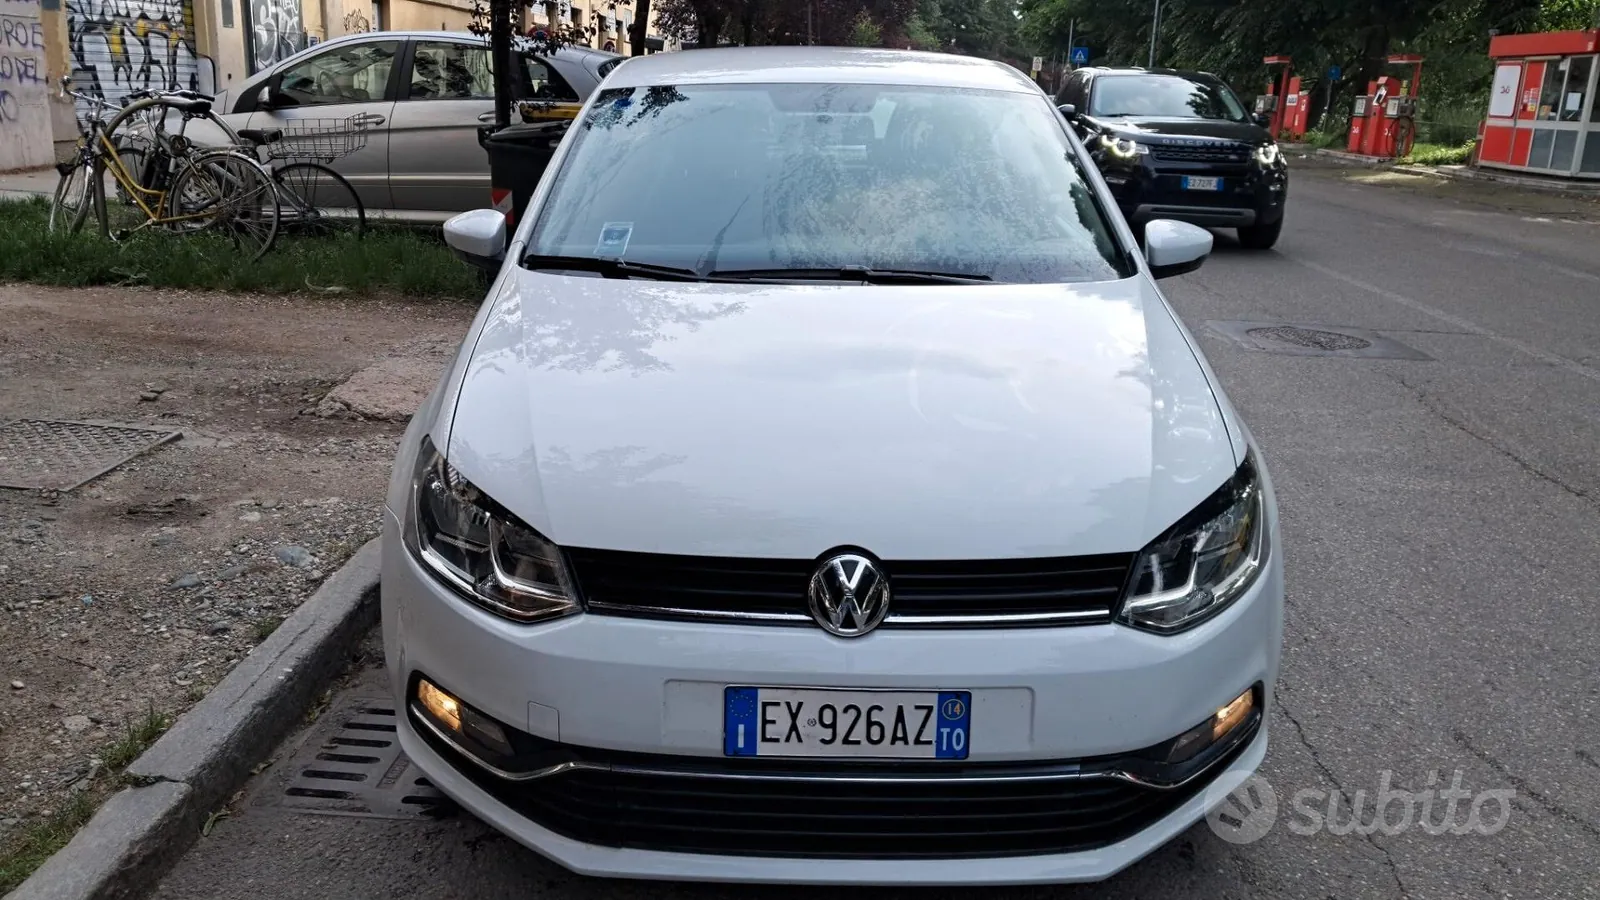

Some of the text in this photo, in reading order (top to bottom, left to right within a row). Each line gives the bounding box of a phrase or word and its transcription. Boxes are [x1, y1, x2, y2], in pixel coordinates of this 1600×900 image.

[1162, 138, 1240, 147] DISCOVERY
[947, 702, 961, 716] 14
[737, 723, 745, 748] I
[940, 727, 965, 751] TO
